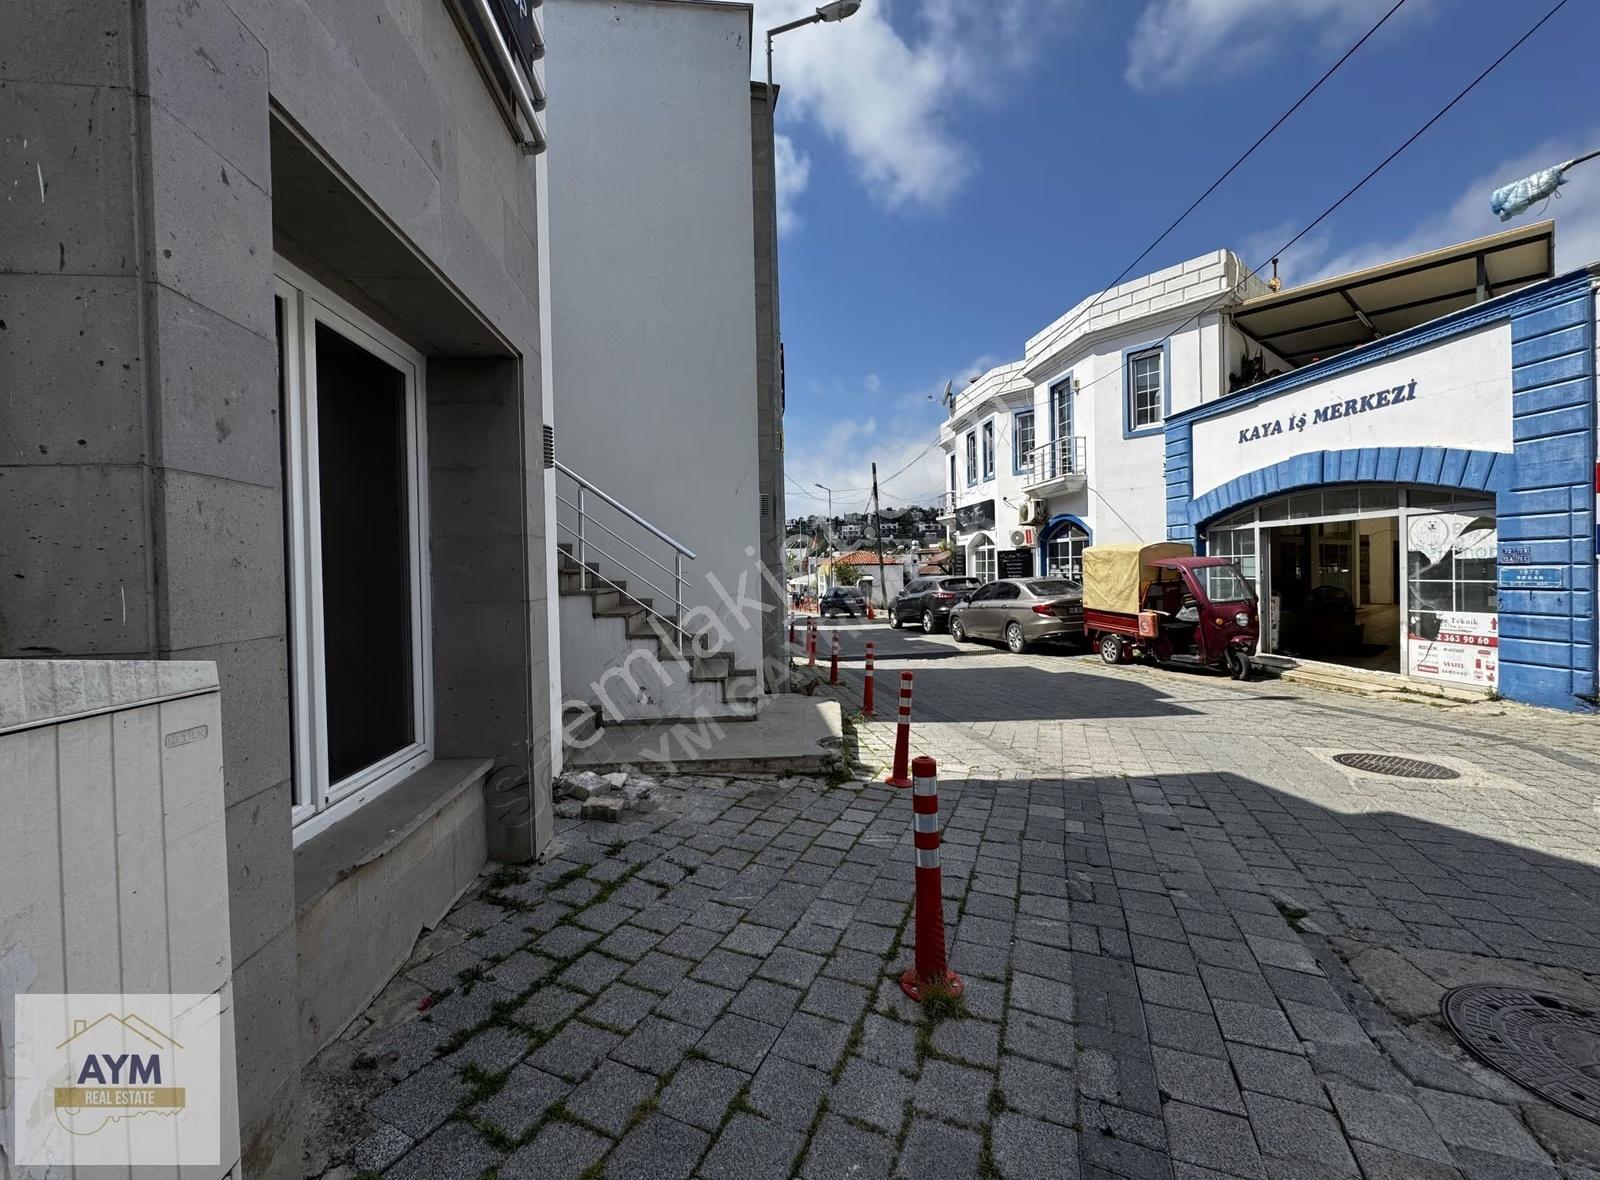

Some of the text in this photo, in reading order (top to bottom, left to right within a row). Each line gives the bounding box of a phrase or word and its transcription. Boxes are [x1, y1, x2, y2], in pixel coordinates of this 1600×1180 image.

[1238, 420, 1283, 444] KAYA
[1312, 378, 1418, 425] MERKEZİ
[1451, 617, 1479, 625] Teknik
[1444, 634, 1460, 642] 363
